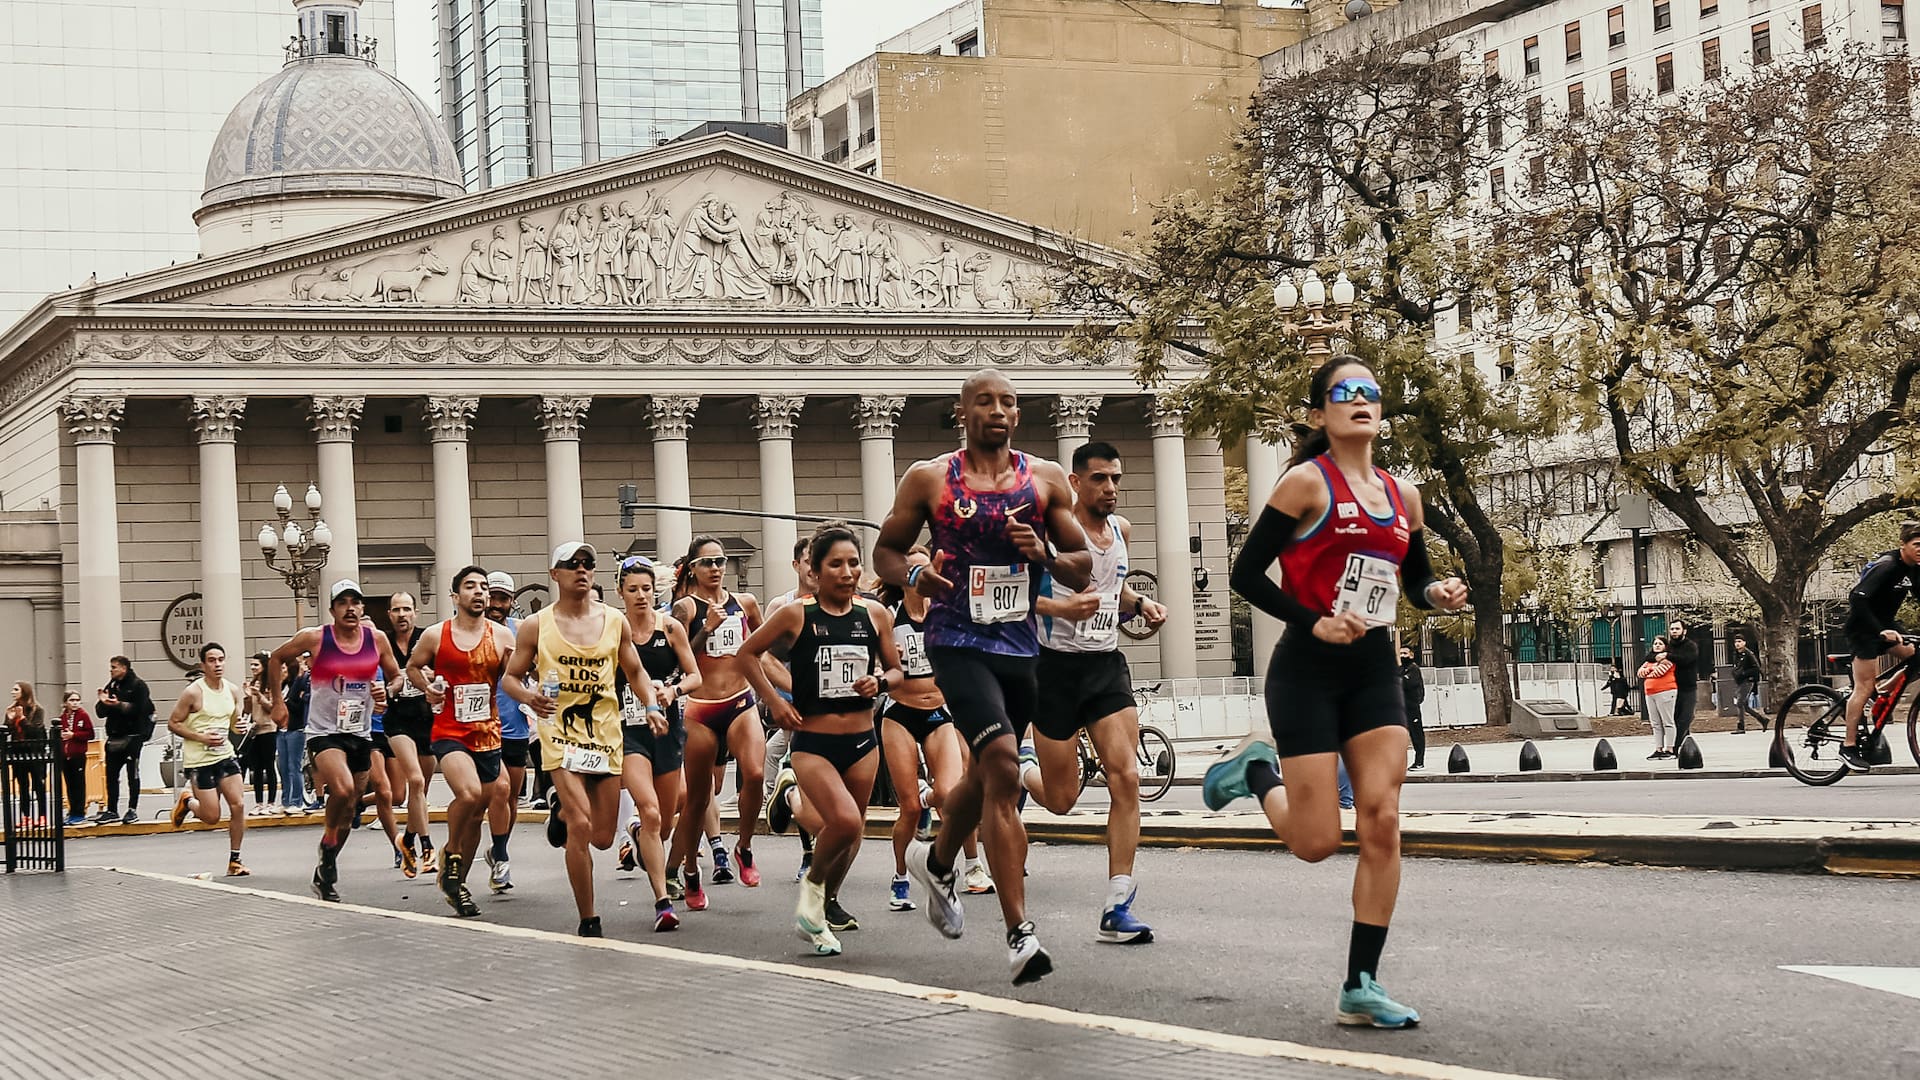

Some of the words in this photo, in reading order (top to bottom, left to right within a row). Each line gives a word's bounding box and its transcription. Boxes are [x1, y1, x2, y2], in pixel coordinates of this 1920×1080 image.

[1348, 558, 1361, 582] A
[973, 569, 983, 589] C
[993, 585, 1019, 610] 807
[1367, 585, 1387, 614] 67
[1091, 612, 1113, 630] 3114
[723, 629, 734, 646] 59
[559, 655, 606, 667] GRUPO
[821, 648, 831, 665] A
[910, 657, 918, 669] 57
[569, 668, 600, 681] LOS
[842, 662, 854, 683] 61
[346, 682, 366, 690] MDC
[457, 687, 464, 700] C
[468, 696, 484, 712] 722
[626, 707, 635, 719] 55
[581, 752, 602, 769] 252
